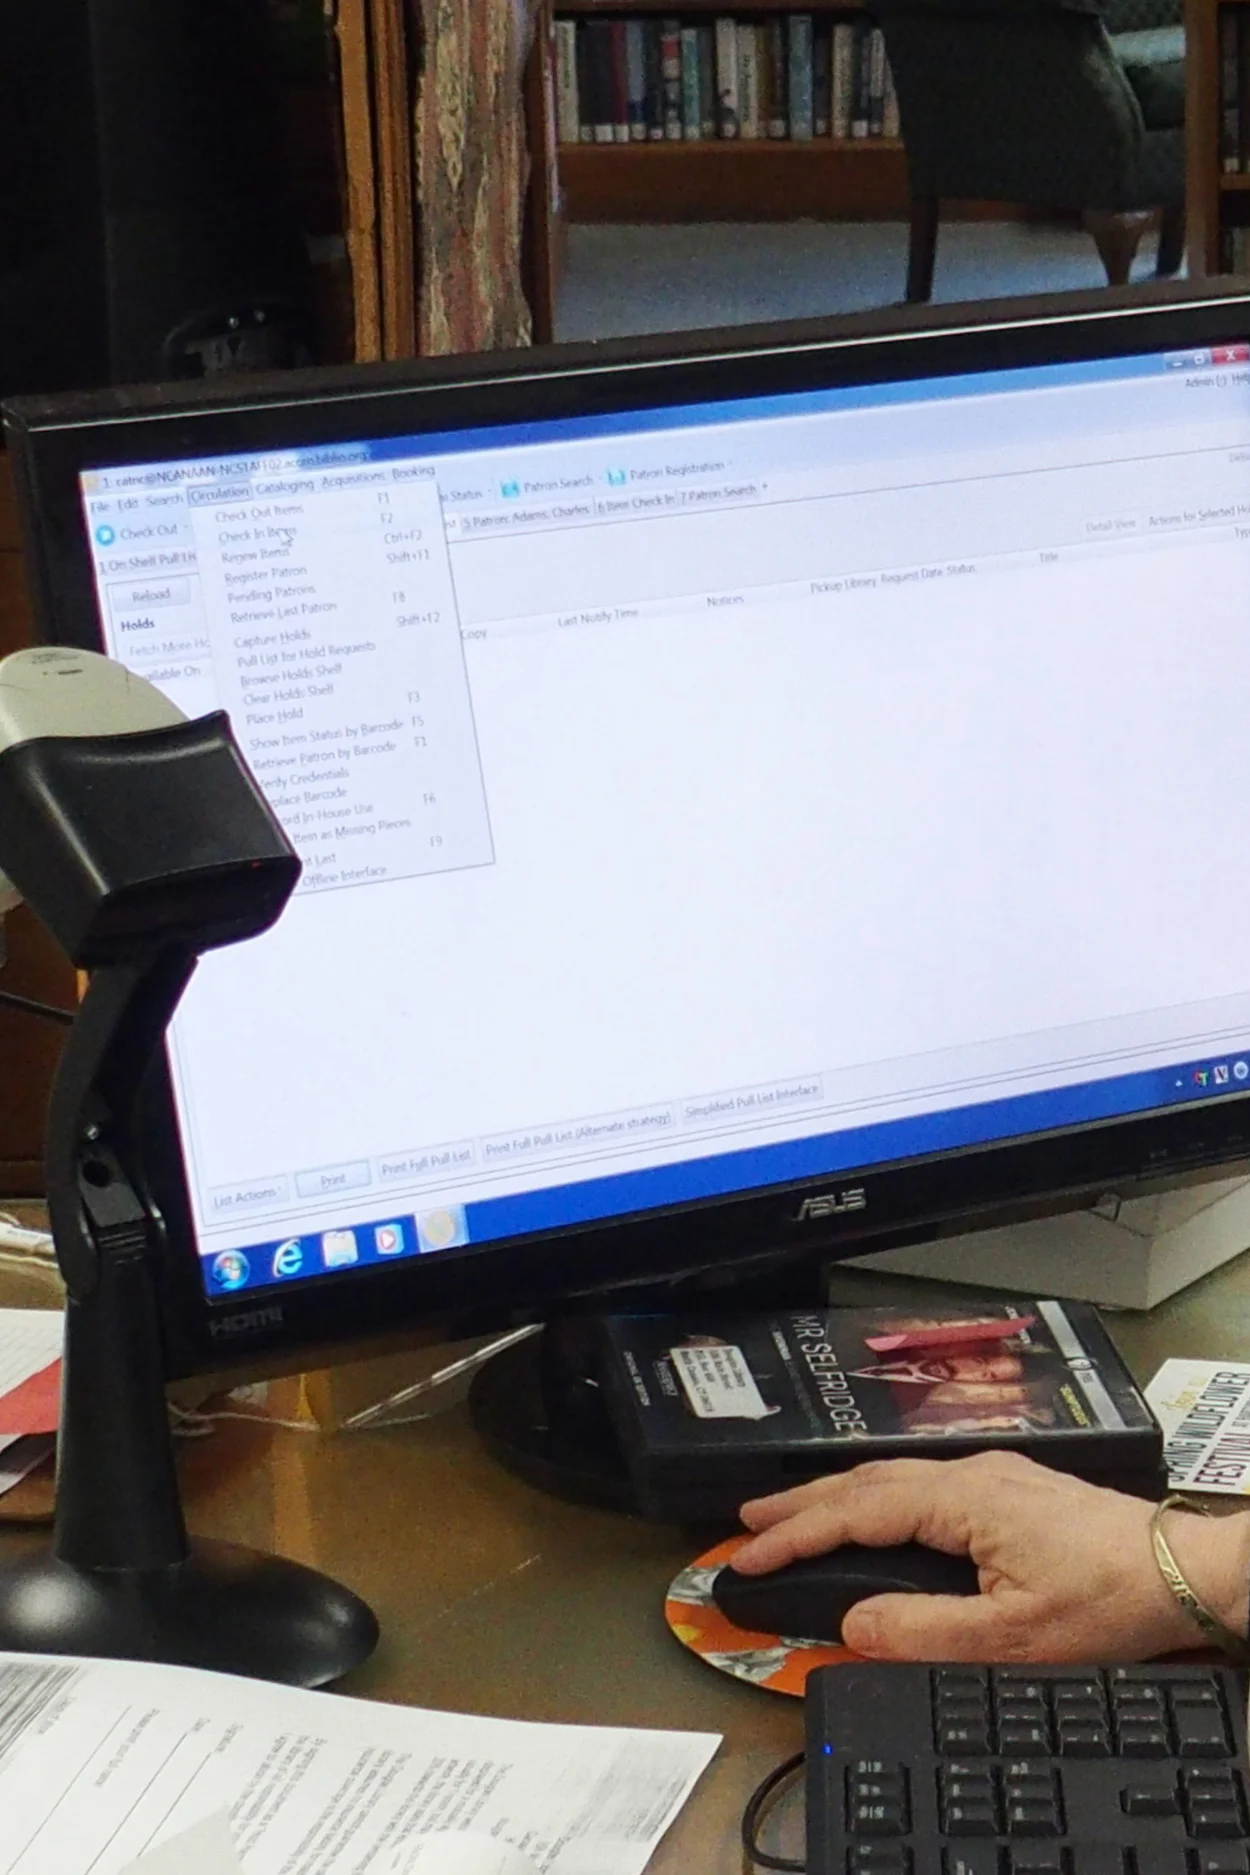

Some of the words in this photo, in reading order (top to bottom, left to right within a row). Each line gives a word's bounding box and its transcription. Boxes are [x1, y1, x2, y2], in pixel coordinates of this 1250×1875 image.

[630, 469, 664, 481] Patron
[665, 460, 725, 477] Registration
[147, 494, 184, 506] Search
[191, 486, 250, 503] Circulation
[256, 480, 315, 496] Cataloging
[322, 471, 385, 488] Acquisitions
[392, 466, 436, 482] Booking
[524, 479, 558, 493] Patron
[560, 474, 594, 489] Search
[689, 488, 722, 501] Patron
[723, 483, 757, 497] Search
[552, 504, 591, 518] Charles
[632, 496, 662, 509] Check
[664, 493, 675, 504] In
[215, 509, 248, 524] Check
[251, 506, 272, 521] Out
[274, 504, 304, 517] Items
[120, 526, 154, 541] Check
[157, 523, 178, 536] Out
[219, 529, 251, 545] Check
[254, 528, 265, 540] In
[380, 512, 394, 525] F2
[109, 558, 127, 572] On
[128, 554, 156, 570] Shelf
[260, 547, 290, 560] Items
[224, 570, 268, 587] Register
[271, 566, 307, 579] Patron
[131, 587, 172, 603] Reload
[227, 589, 273, 604] Pending
[275, 585, 317, 599] Patrons
[460, 628, 488, 641] Copy
[558, 615, 578, 628] Last
[580, 610, 613, 626] Notify
[614, 607, 639, 619] Time
[810, 582, 844, 595] Pickup
[845, 576, 877, 591] Library
[881, 570, 920, 585] Request
[921, 567, 945, 580] Date
[946, 562, 977, 576] Status
[1039, 551, 1060, 564] Title
[231, 609, 276, 624] Retrieve
[277, 605, 299, 621] Last
[301, 601, 338, 615] Patron
[121, 617, 156, 632] Holds
[234, 635, 277, 650] Capture
[280, 628, 312, 644] Holds
[237, 656, 258, 669] Pull
[299, 645, 327, 660] Hold
[328, 641, 376, 656] Requests
[241, 673, 281, 688] Browse
[283, 668, 313, 682] Holds
[315, 663, 343, 677] Shelf
[246, 712, 275, 726] Place
[277, 707, 304, 723] Hold
[250, 737, 280, 751] Show
[345, 726, 359, 740] by
[360, 719, 405, 736] Barcode
[300, 748, 336, 766] Patron
[337, 747, 352, 761] by
[353, 741, 397, 756] Barcode
[290, 766, 350, 786] Credentials
[303, 786, 349, 804] Barcode
[378, 817, 412, 832] Pieces
[341, 864, 388, 883] Interface
[736, 1094, 756, 1110] Pull
[757, 1090, 775, 1106] List
[776, 1083, 819, 1101] Interface
[485, 1141, 511, 1157] Print
[512, 1136, 532, 1151] Full
[533, 1131, 554, 1148] Pull
[555, 1128, 574, 1144] List
[381, 1161, 408, 1177] Print
[430, 1152, 451, 1168] Pull
[453, 1149, 472, 1164] List
[320, 1172, 347, 1190] Print
[213, 1195, 233, 1210] List
[234, 1186, 277, 1204] Actions
[791, 1187, 868, 1223] ASUS
[209, 1306, 284, 1337] HDMI
[790, 1314, 826, 1340] MR
[801, 1342, 868, 1433] SELFRIDGE
